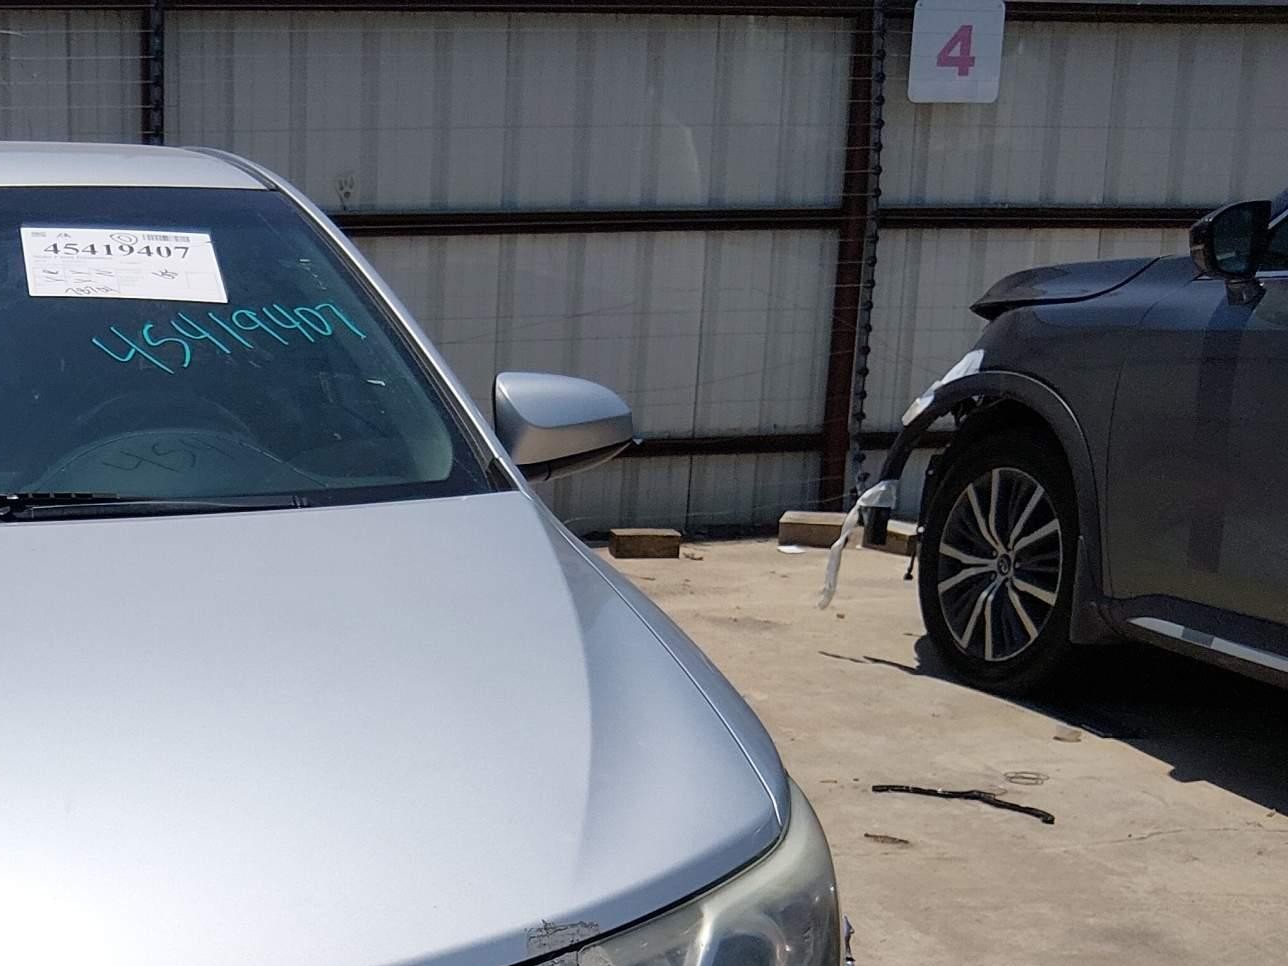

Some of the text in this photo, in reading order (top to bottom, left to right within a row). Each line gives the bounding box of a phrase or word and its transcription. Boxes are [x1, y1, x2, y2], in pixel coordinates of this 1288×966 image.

[936, 25, 976, 76] 4
[43, 242, 191, 260] 45419407
[91, 302, 367, 375] 45419407
